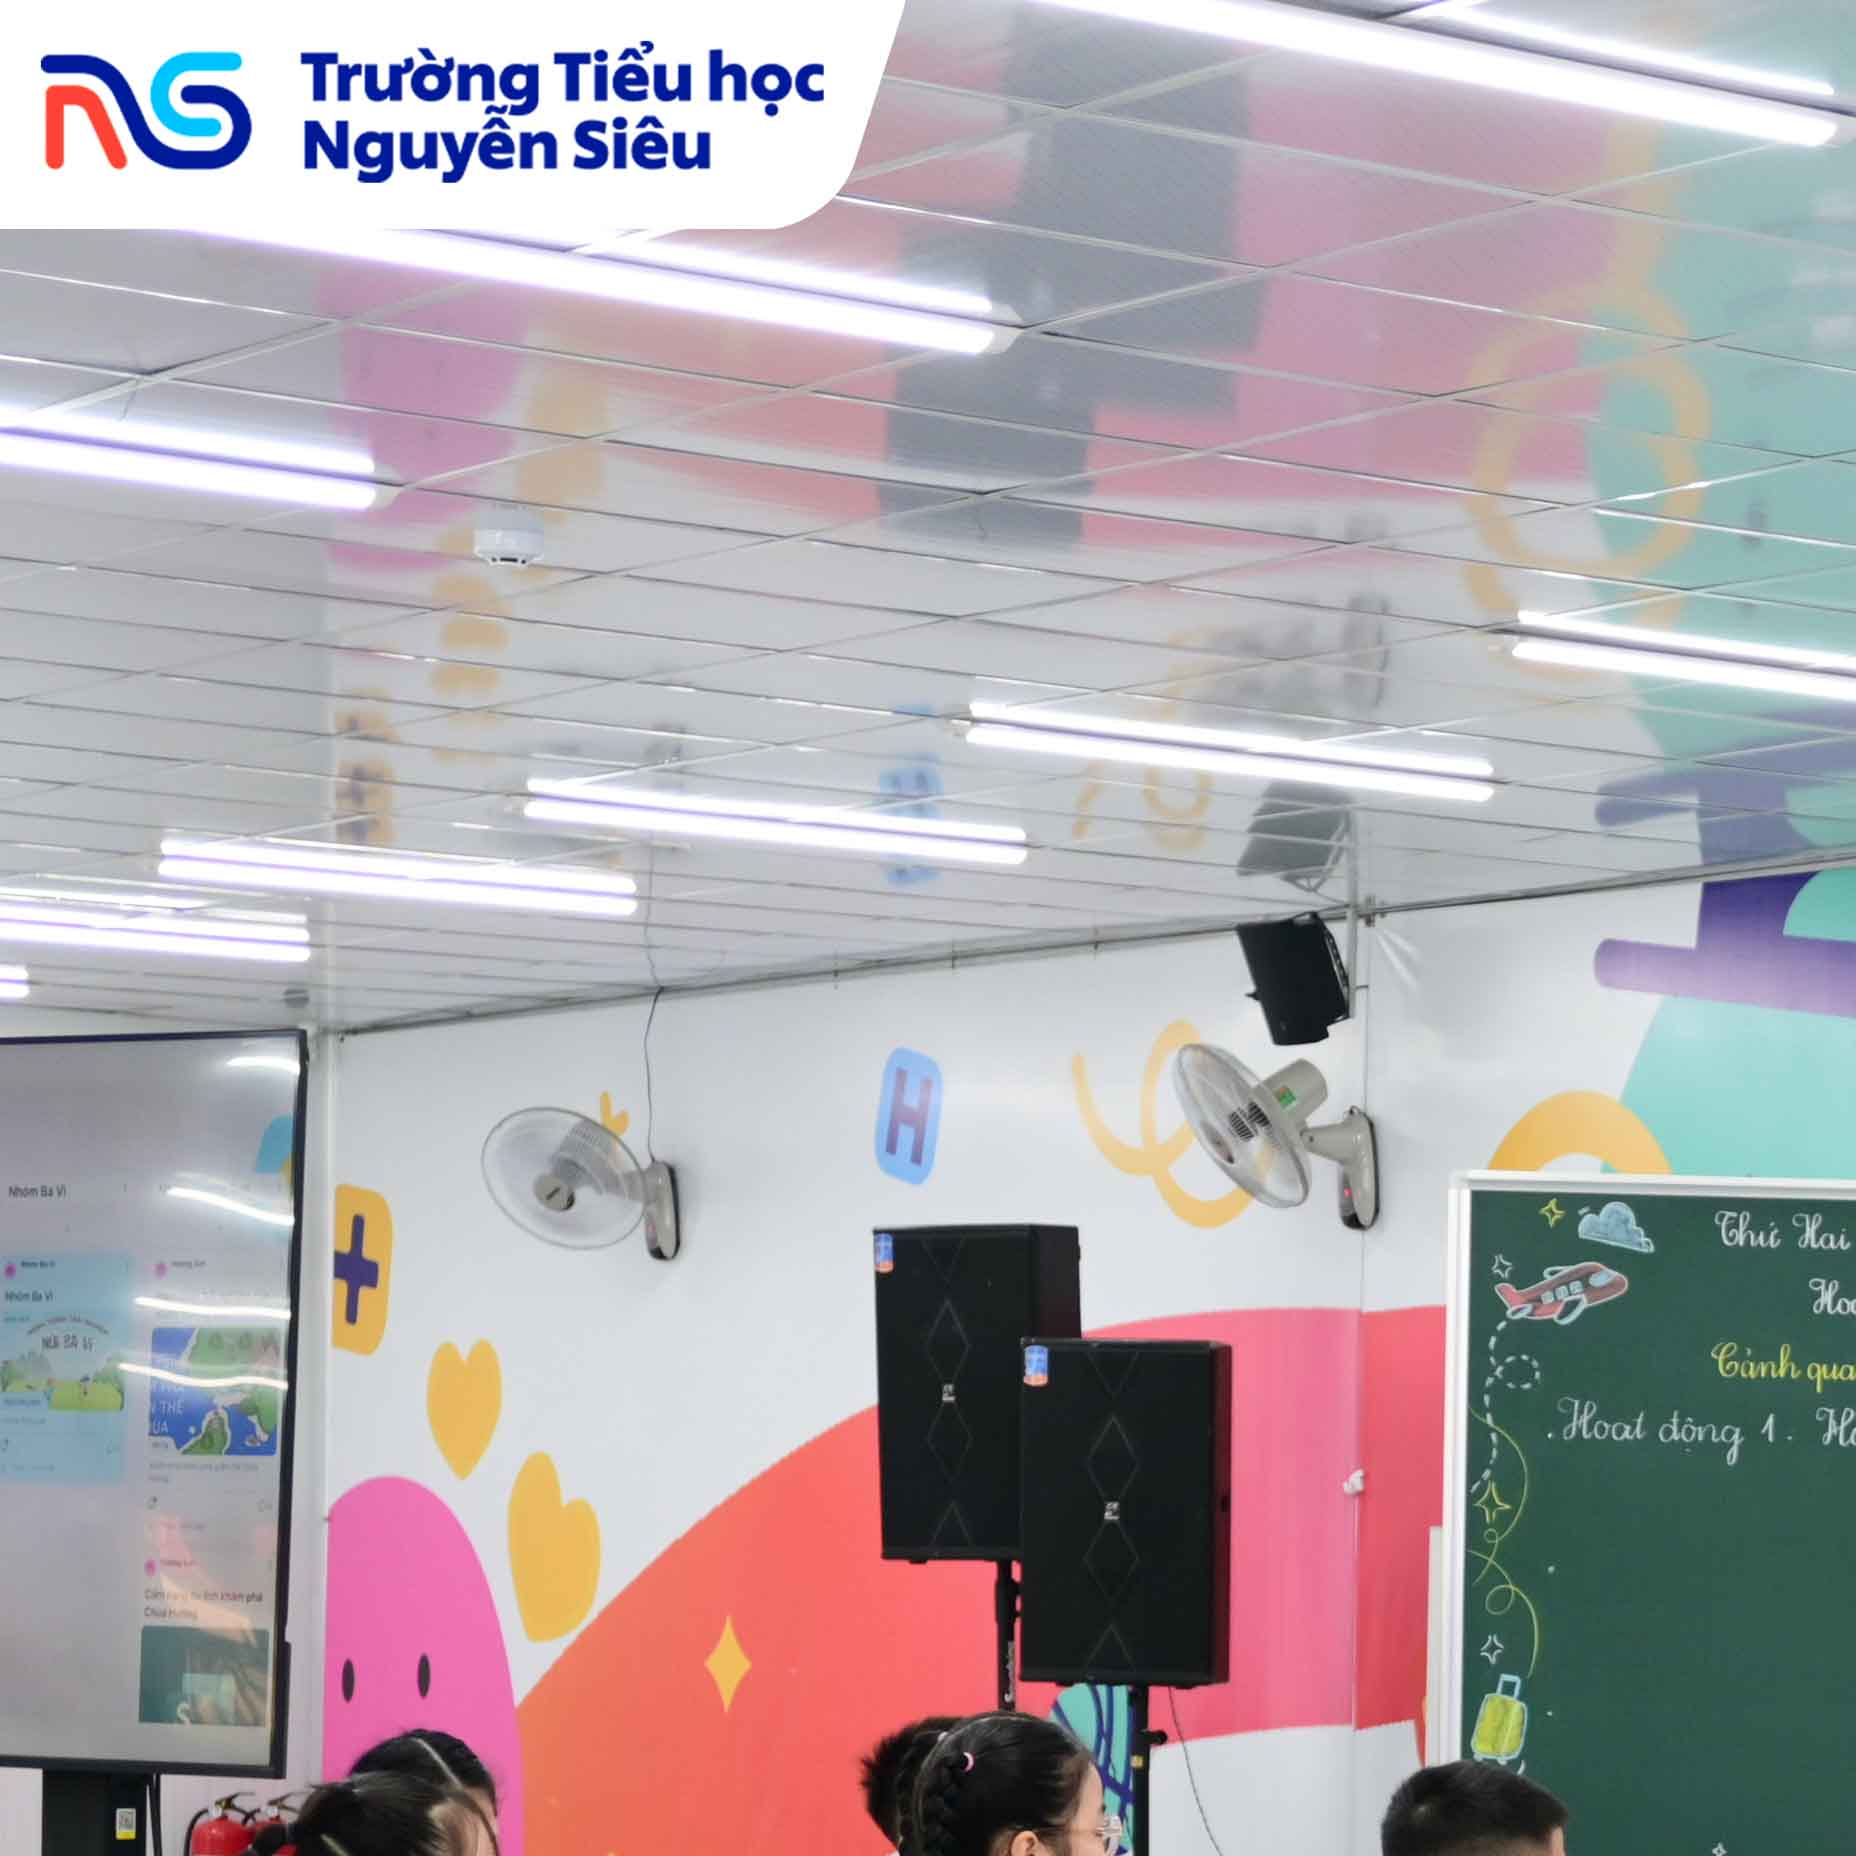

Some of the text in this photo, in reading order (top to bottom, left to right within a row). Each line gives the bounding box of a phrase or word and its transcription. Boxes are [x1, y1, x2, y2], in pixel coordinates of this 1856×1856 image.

[1714, 1209, 1781, 1249] Thứ
[1792, 1213, 1850, 1251] Hai
[1710, 1342, 1801, 1381] Cảnh
[1659, 1409, 1744, 1465] động
